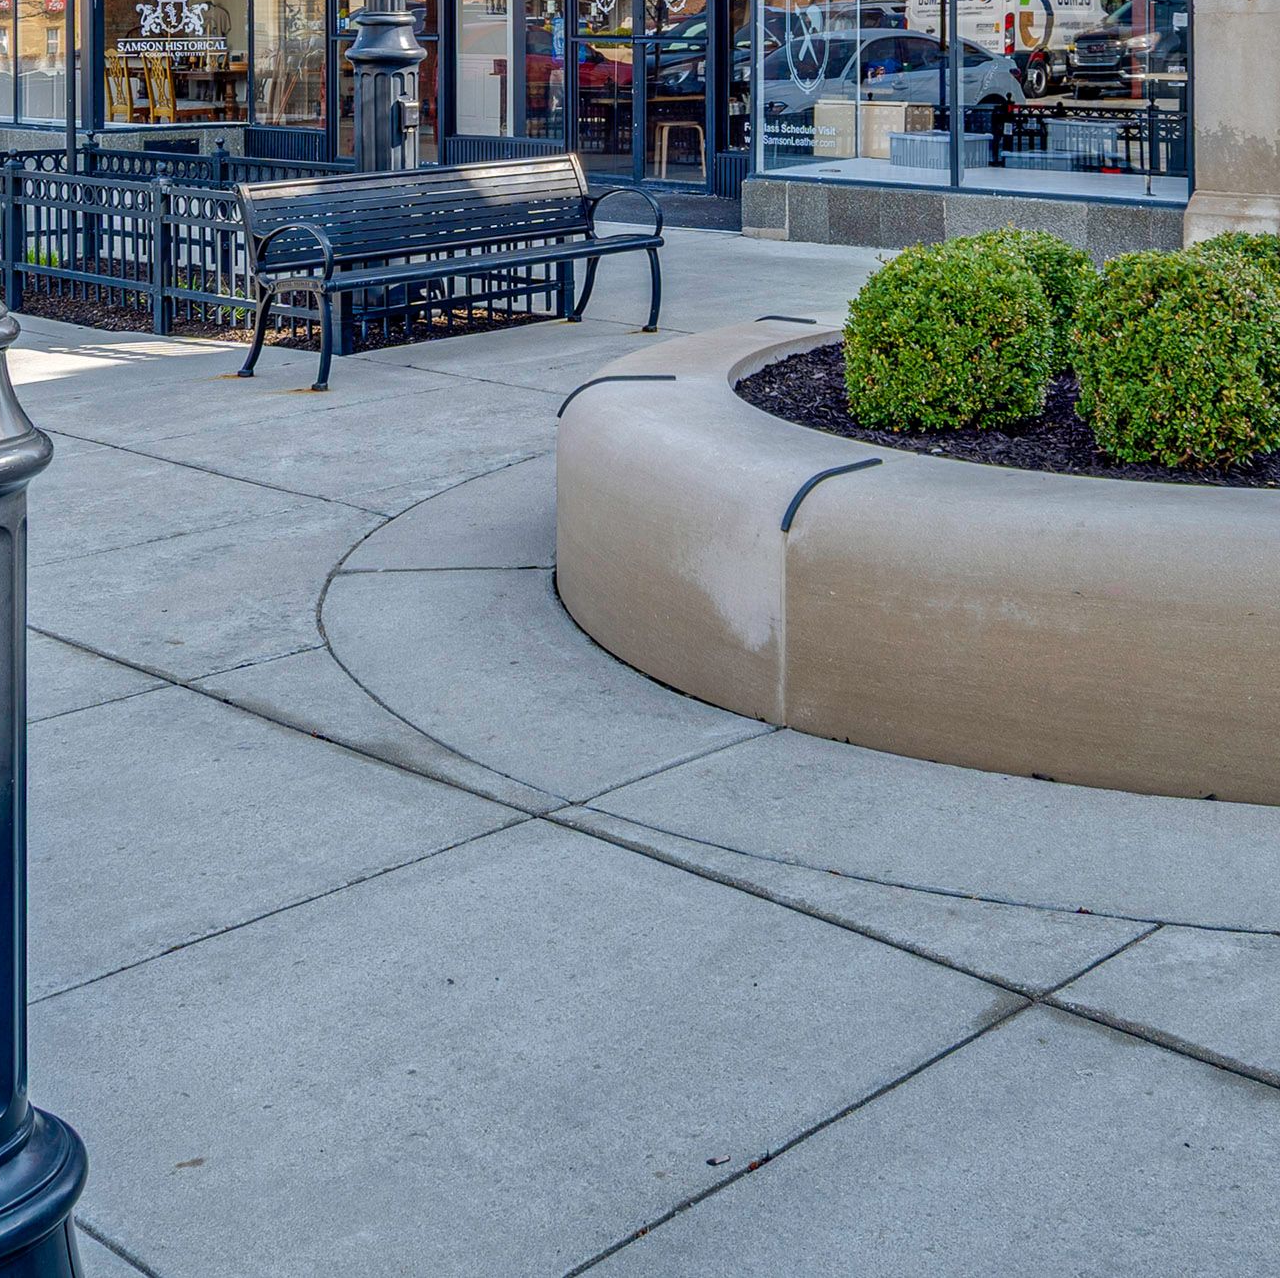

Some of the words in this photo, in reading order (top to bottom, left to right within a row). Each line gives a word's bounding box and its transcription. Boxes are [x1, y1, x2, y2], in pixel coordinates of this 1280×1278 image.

[117, 41, 163, 52] SAMSON
[165, 40, 227, 51] HISTORICAL
[763, 123, 780, 134] lass
[781, 123, 817, 136] Schedule
[818, 125, 836, 136] Visit
